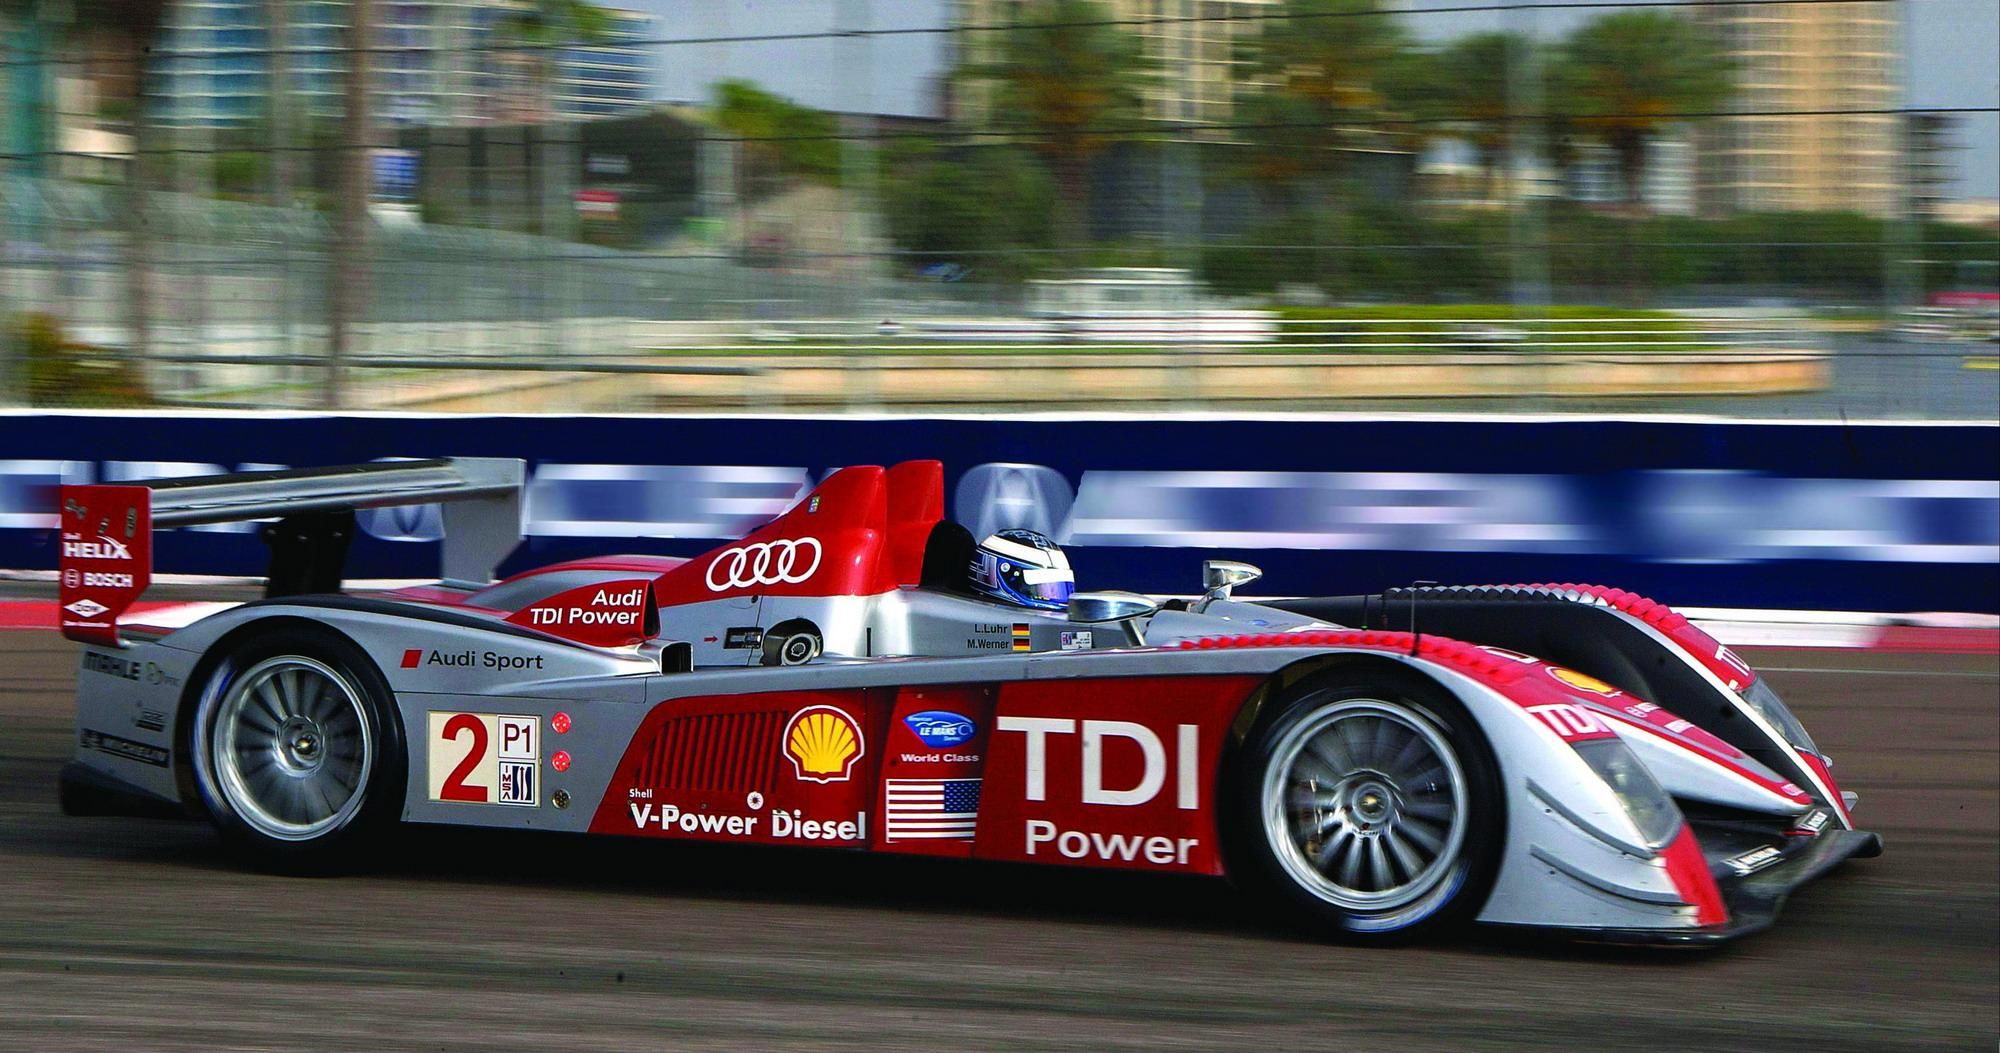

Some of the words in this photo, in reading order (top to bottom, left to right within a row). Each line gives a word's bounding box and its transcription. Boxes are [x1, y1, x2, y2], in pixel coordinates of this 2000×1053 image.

[63, 539, 133, 560] HELIX
[83, 572, 133, 588] BOSCH
[592, 589, 642, 606] Audi
[530, 608, 562, 625] TDI
[568, 608, 639, 625] Power
[974, 623, 1008, 634] L.Luhr
[967, 638, 1009, 650] M.Werner
[427, 650, 476, 667] Audi
[483, 652, 544, 671] Sport
[504, 723, 531, 753] P1
[440, 714, 488, 803] 2
[901, 753, 940, 763] World
[942, 753, 980, 763] Class
[997, 716, 1199, 810] TDI
[629, 788, 653, 799] Shell
[630, 803, 758, 836] V-Power
[771, 809, 867, 840] Diesel
[1026, 819, 1199, 865] Power
